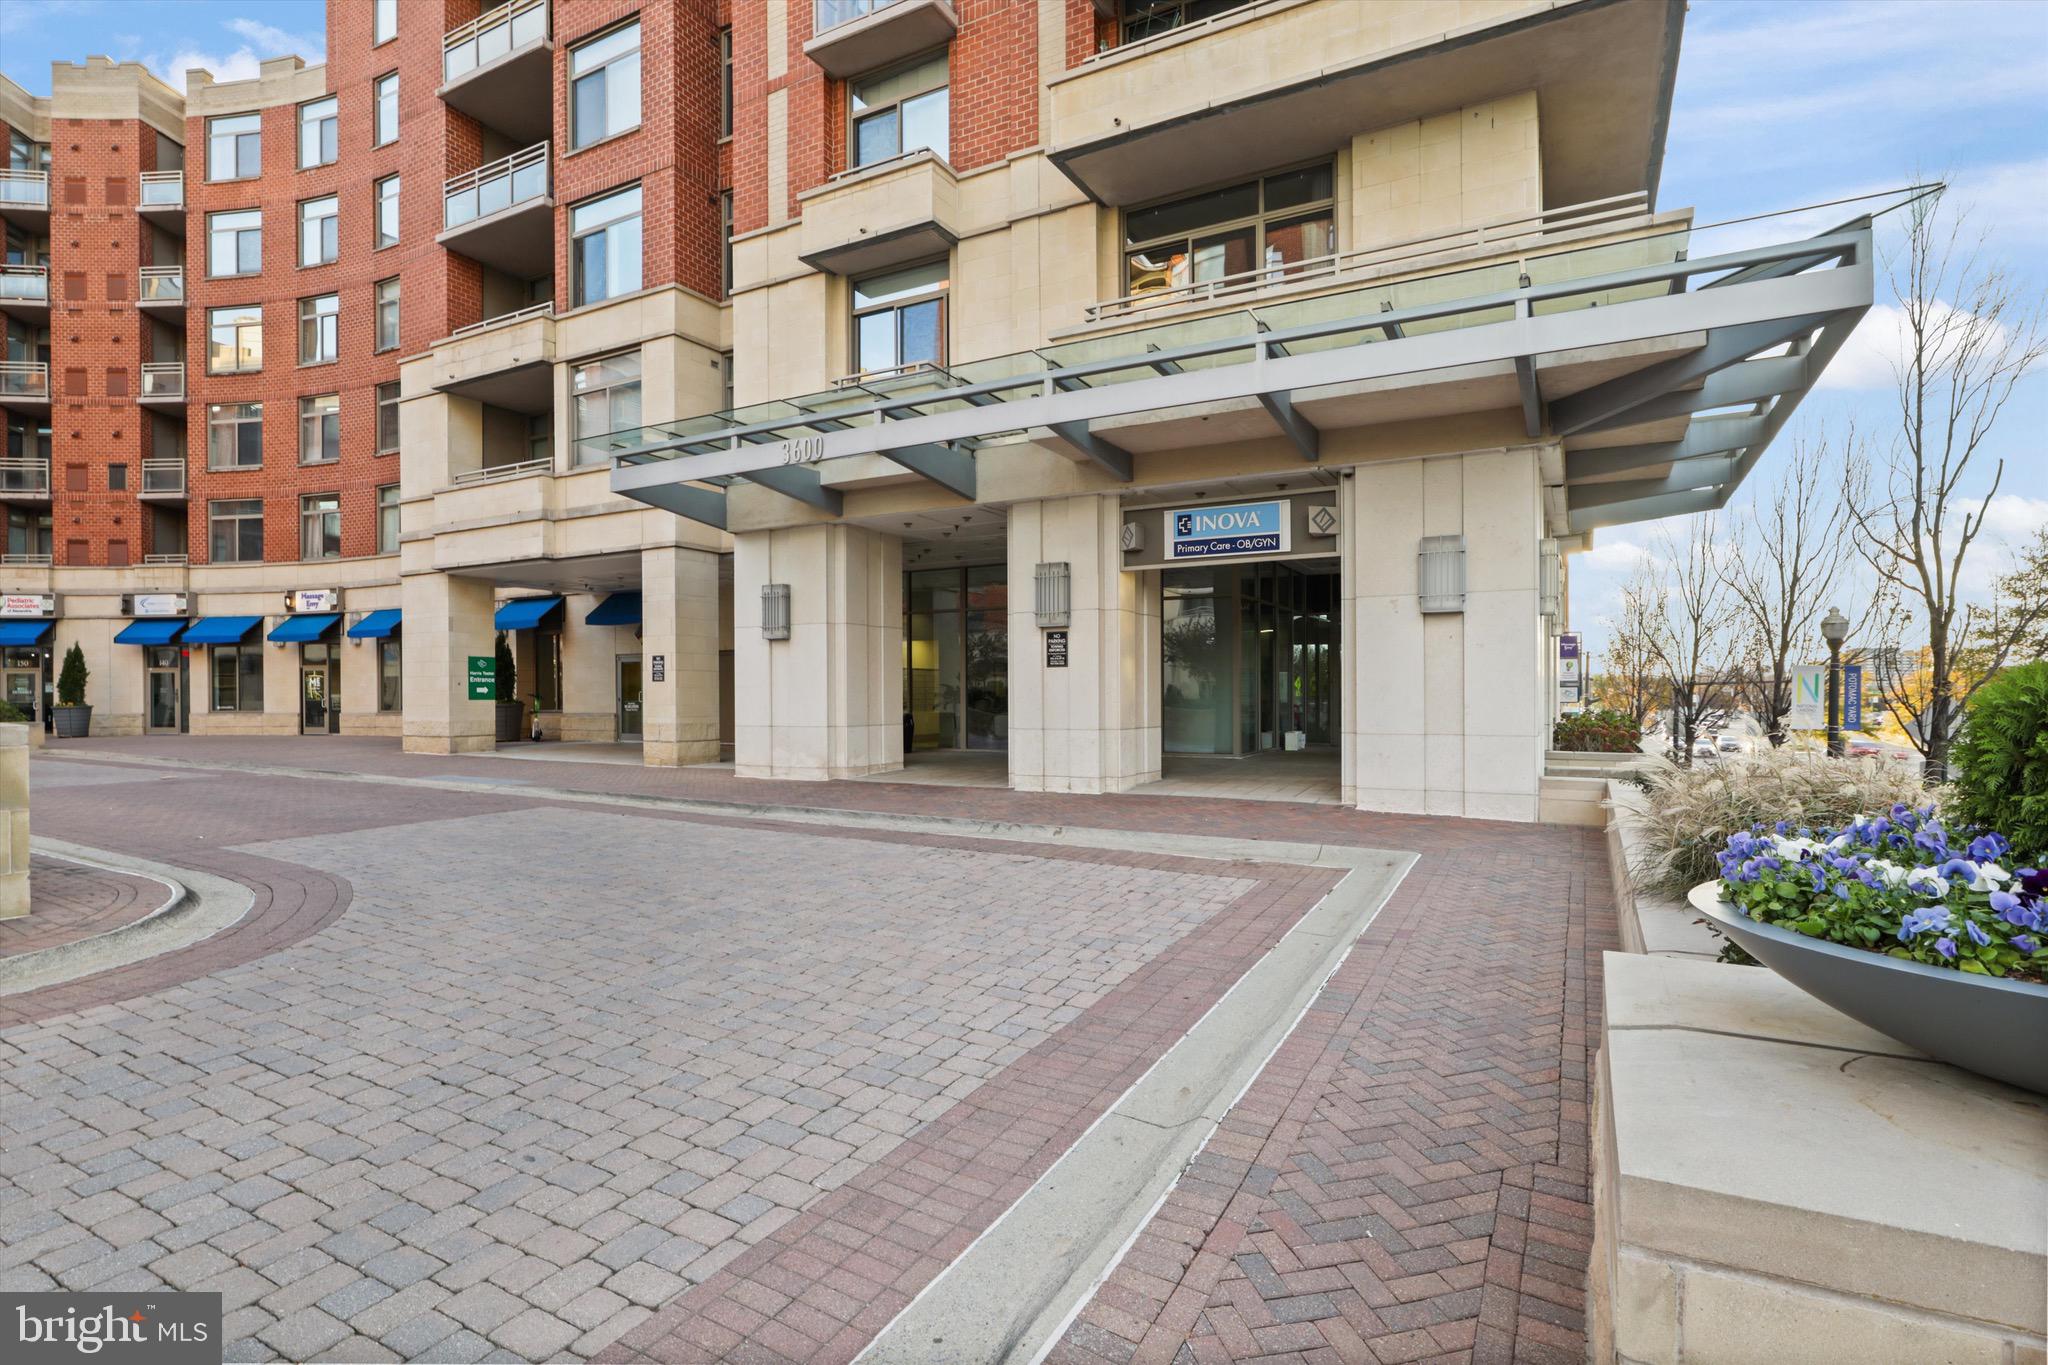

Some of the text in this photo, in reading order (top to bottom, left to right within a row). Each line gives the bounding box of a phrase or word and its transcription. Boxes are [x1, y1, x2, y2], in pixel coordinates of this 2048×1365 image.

[783, 436, 824, 464] 3600
[1195, 511, 1260, 532] INOVA
[1177, 544, 1209, 554] Primary
[1210, 541, 1231, 551] Care
[1236, 537, 1277, 550] OB/GYN
[1848, 673, 1857, 723] POTOMAC YARD
